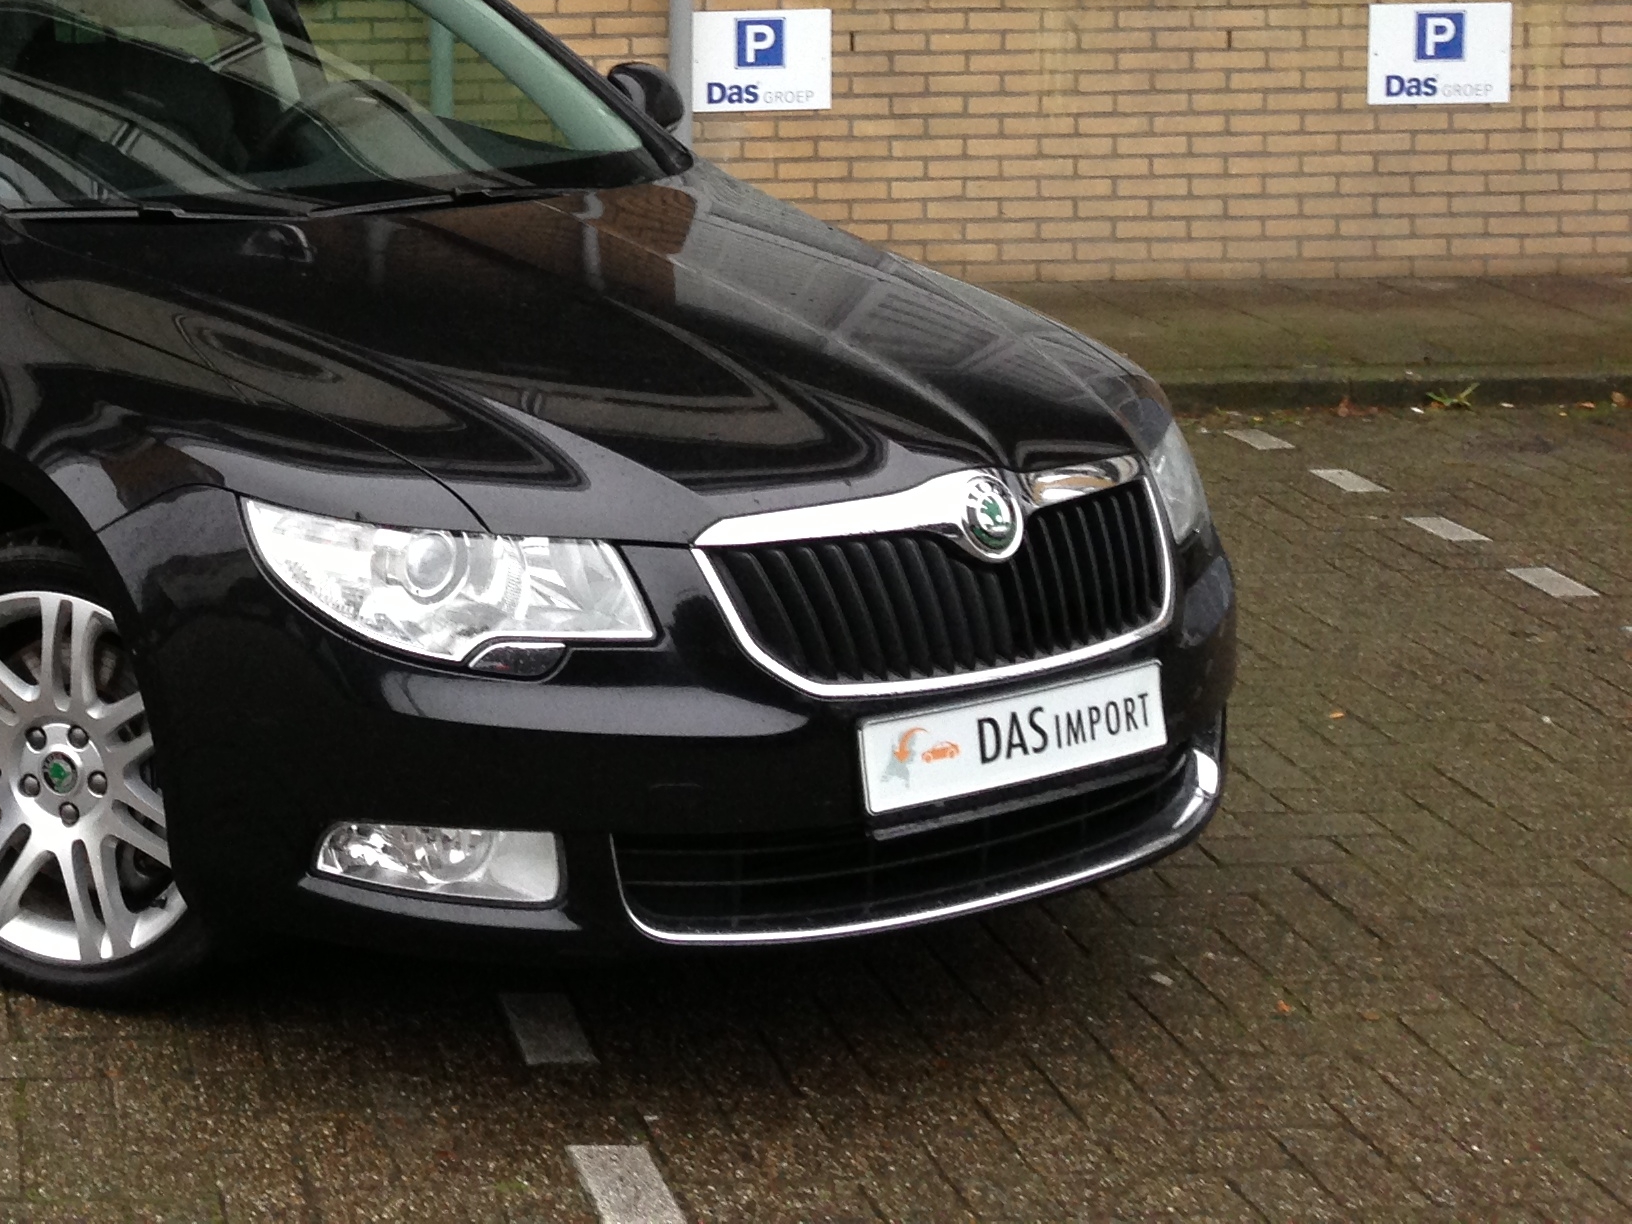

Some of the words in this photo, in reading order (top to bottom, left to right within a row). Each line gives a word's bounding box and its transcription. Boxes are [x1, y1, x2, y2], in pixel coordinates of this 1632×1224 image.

[745, 24, 776, 63] P
[1425, 17, 1456, 56] P
[707, 82, 759, 104] Das
[763, 90, 815, 104] GROEP
[1385, 75, 1438, 97] Das
[1441, 84, 1494, 98] GROEP
[977, 706, 1049, 764] DAS
[1054, 693, 1150, 749] IMPORT
